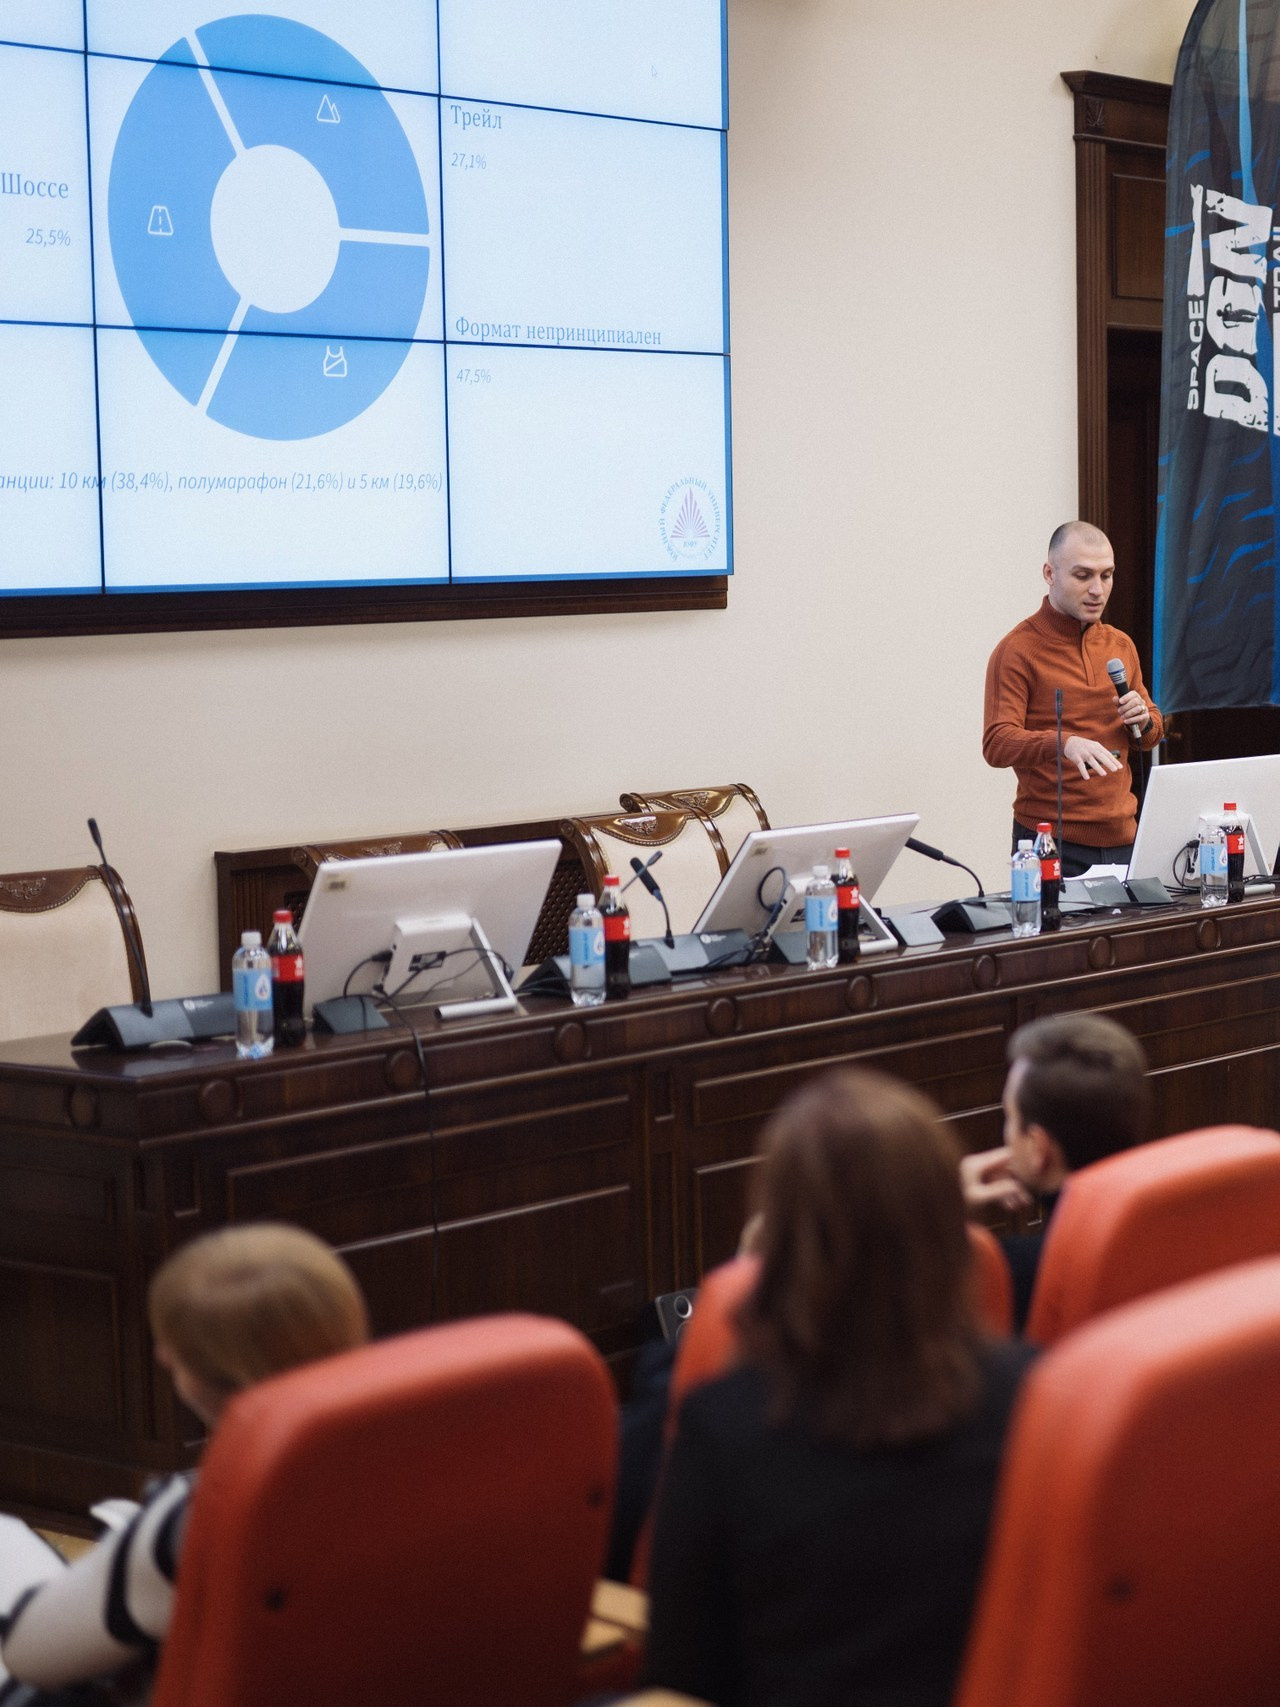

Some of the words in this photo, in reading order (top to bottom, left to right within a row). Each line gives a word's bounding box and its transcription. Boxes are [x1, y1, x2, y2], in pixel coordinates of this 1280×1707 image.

[450, 104, 502, 131] Трейл
[451, 152, 487, 171] 27,1%
[1, 172, 69, 199] Шоссе
[25, 227, 72, 248] 25,5%
[1203, 188, 1274, 433] DON
[455, 316, 521, 341] Формат
[526, 325, 662, 345] непринципиален
[1187, 299, 1204, 410] SPACE
[456, 368, 492, 385] 47,5%
[59, 472, 78, 489] 10
[82, 475, 106, 489] км
[111, 471, 173, 493] (38,4%),
[178, 472, 287, 493] полумарафон
[291, 472, 344, 493] (21,6%)
[347, 477, 356, 489] и
[360, 473, 368, 489] 5
[371, 477, 389, 489] км
[393, 473, 443, 493] (19,6%)
